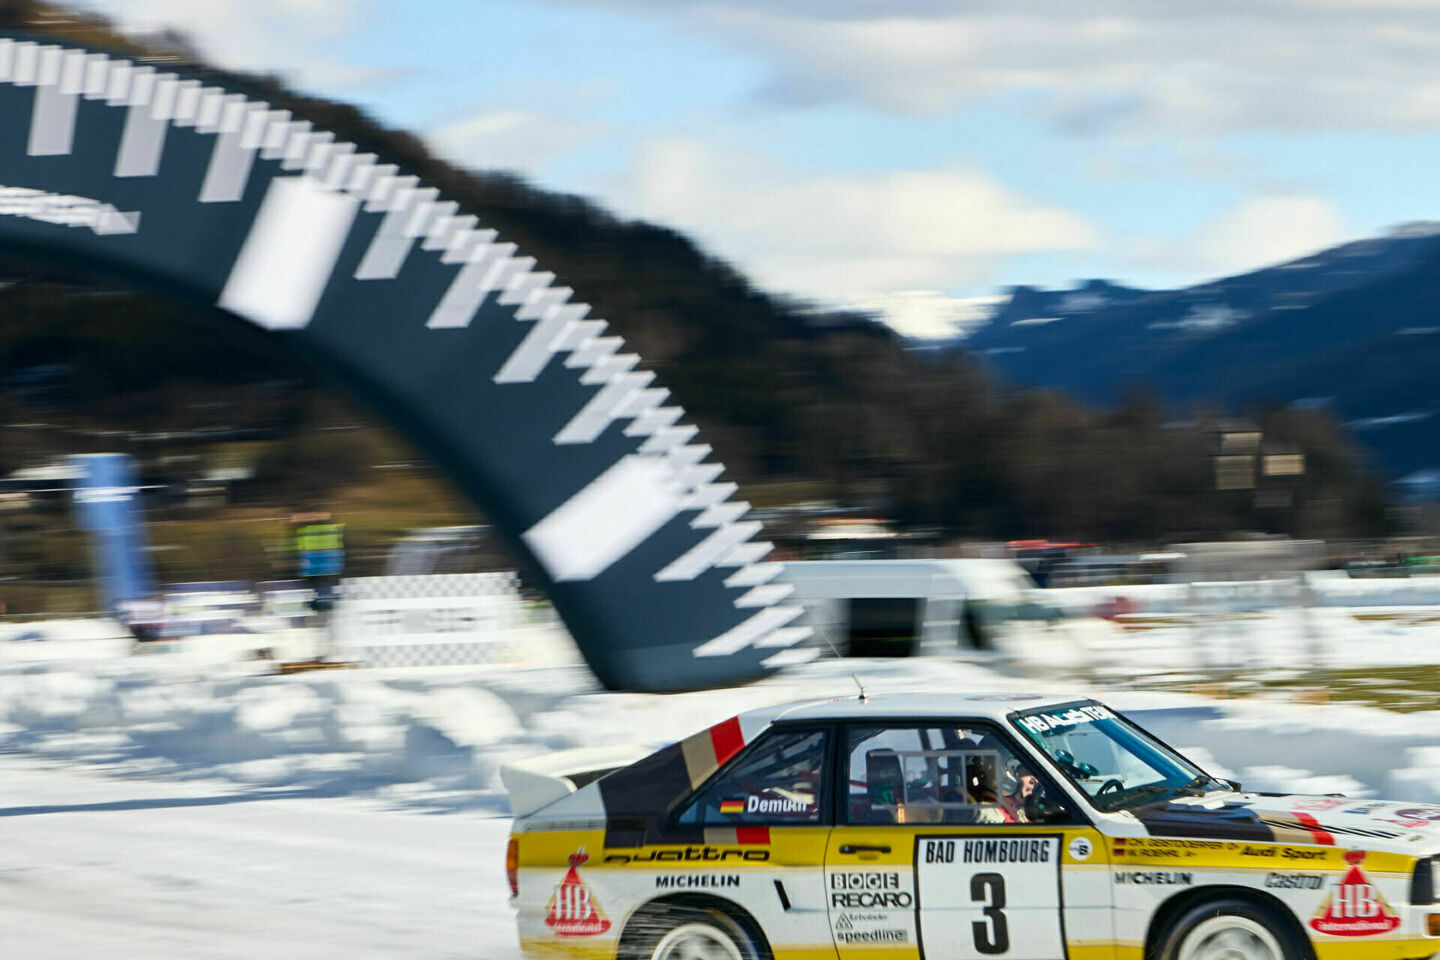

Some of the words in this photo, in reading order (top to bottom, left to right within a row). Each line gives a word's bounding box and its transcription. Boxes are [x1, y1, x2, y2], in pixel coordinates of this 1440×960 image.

[1018, 715, 1051, 734] HB
[747, 795, 807, 813] Demuth
[604, 847, 770, 866] quattro
[926, 841, 955, 864] BAD
[963, 840, 1050, 864] HOMBOURG
[1240, 845, 1278, 858] Audi
[1281, 847, 1328, 861] Sport
[655, 874, 740, 888] MICHELIN
[831, 873, 899, 889] BOGE
[1114, 871, 1194, 885] MICHELIN
[554, 884, 593, 920] HB
[831, 892, 913, 908] RECARO
[1330, 883, 1379, 919] HB
[970, 872, 1010, 955] 3
[837, 929, 904, 943] speedline
